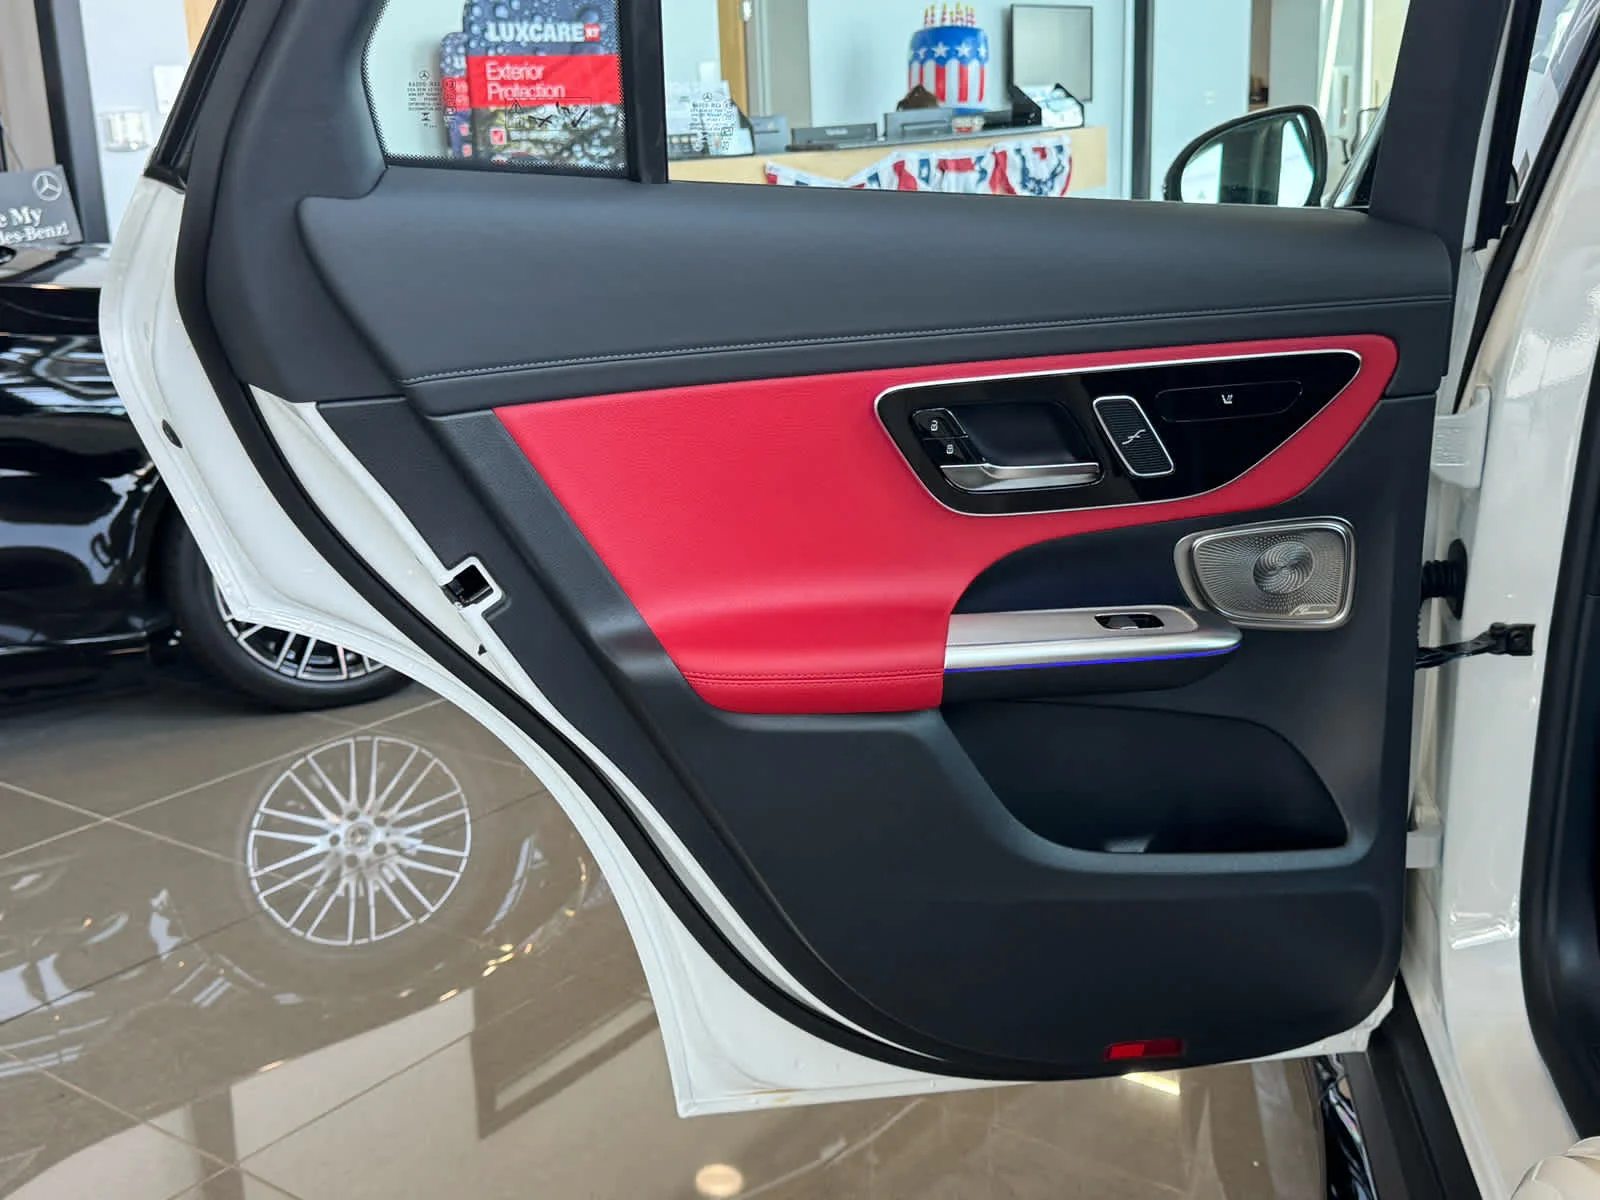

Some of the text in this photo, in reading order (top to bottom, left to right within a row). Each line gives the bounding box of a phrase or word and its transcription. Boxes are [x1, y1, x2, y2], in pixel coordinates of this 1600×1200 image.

[486, 22, 584, 42] LUXCARE
[486, 61, 545, 80] Exterior
[487, 82, 566, 101] Protection
[8, 206, 42, 227] My
